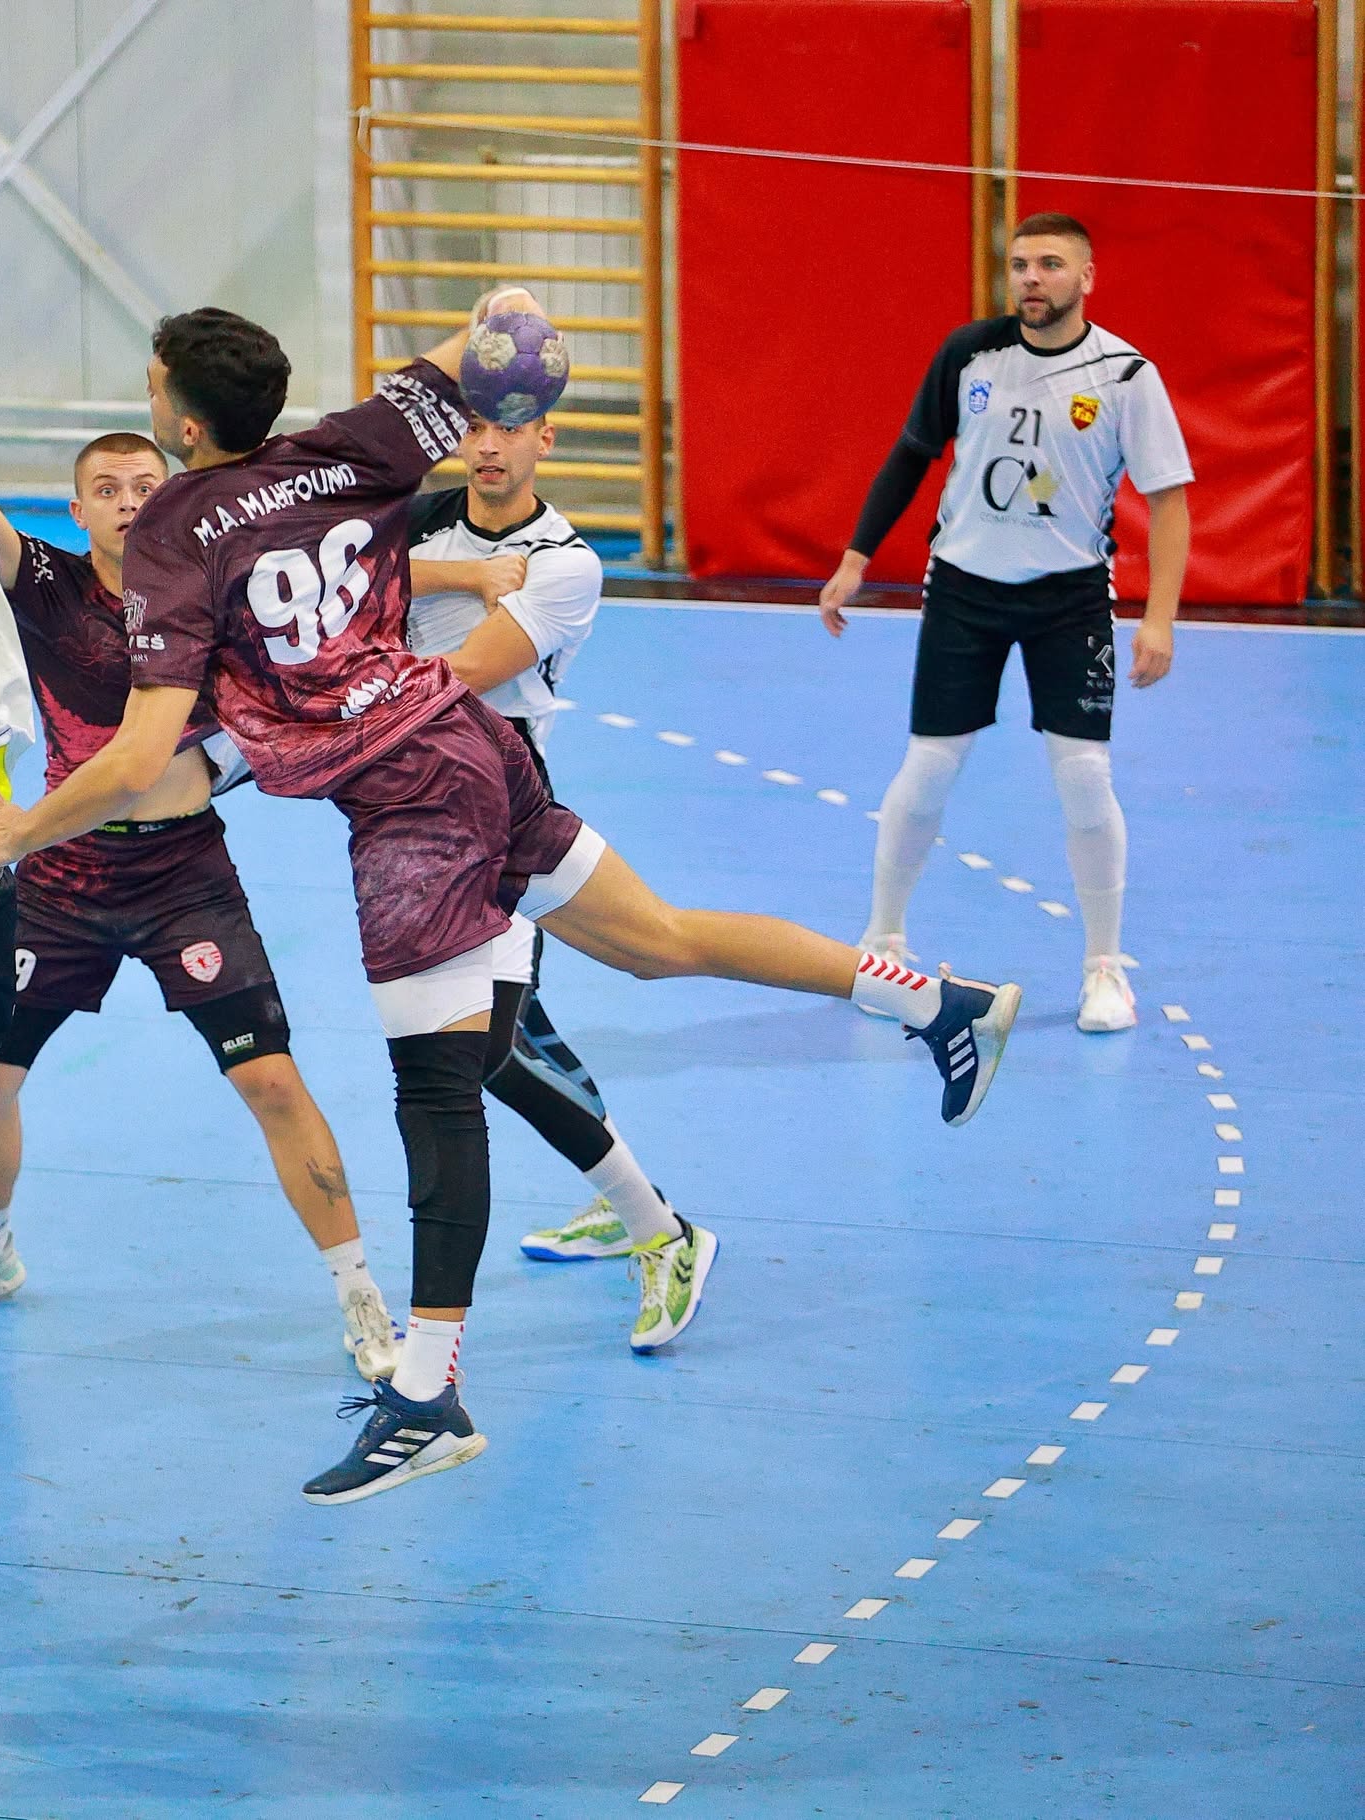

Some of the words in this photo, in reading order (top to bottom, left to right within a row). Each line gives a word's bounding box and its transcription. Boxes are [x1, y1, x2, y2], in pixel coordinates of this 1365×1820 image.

[1008, 406, 1042, 446] 21
[236, 463, 357, 520] MAHFOUND
[247, 518, 374, 665] 96
[221, 1032, 254, 1052] SELECT
